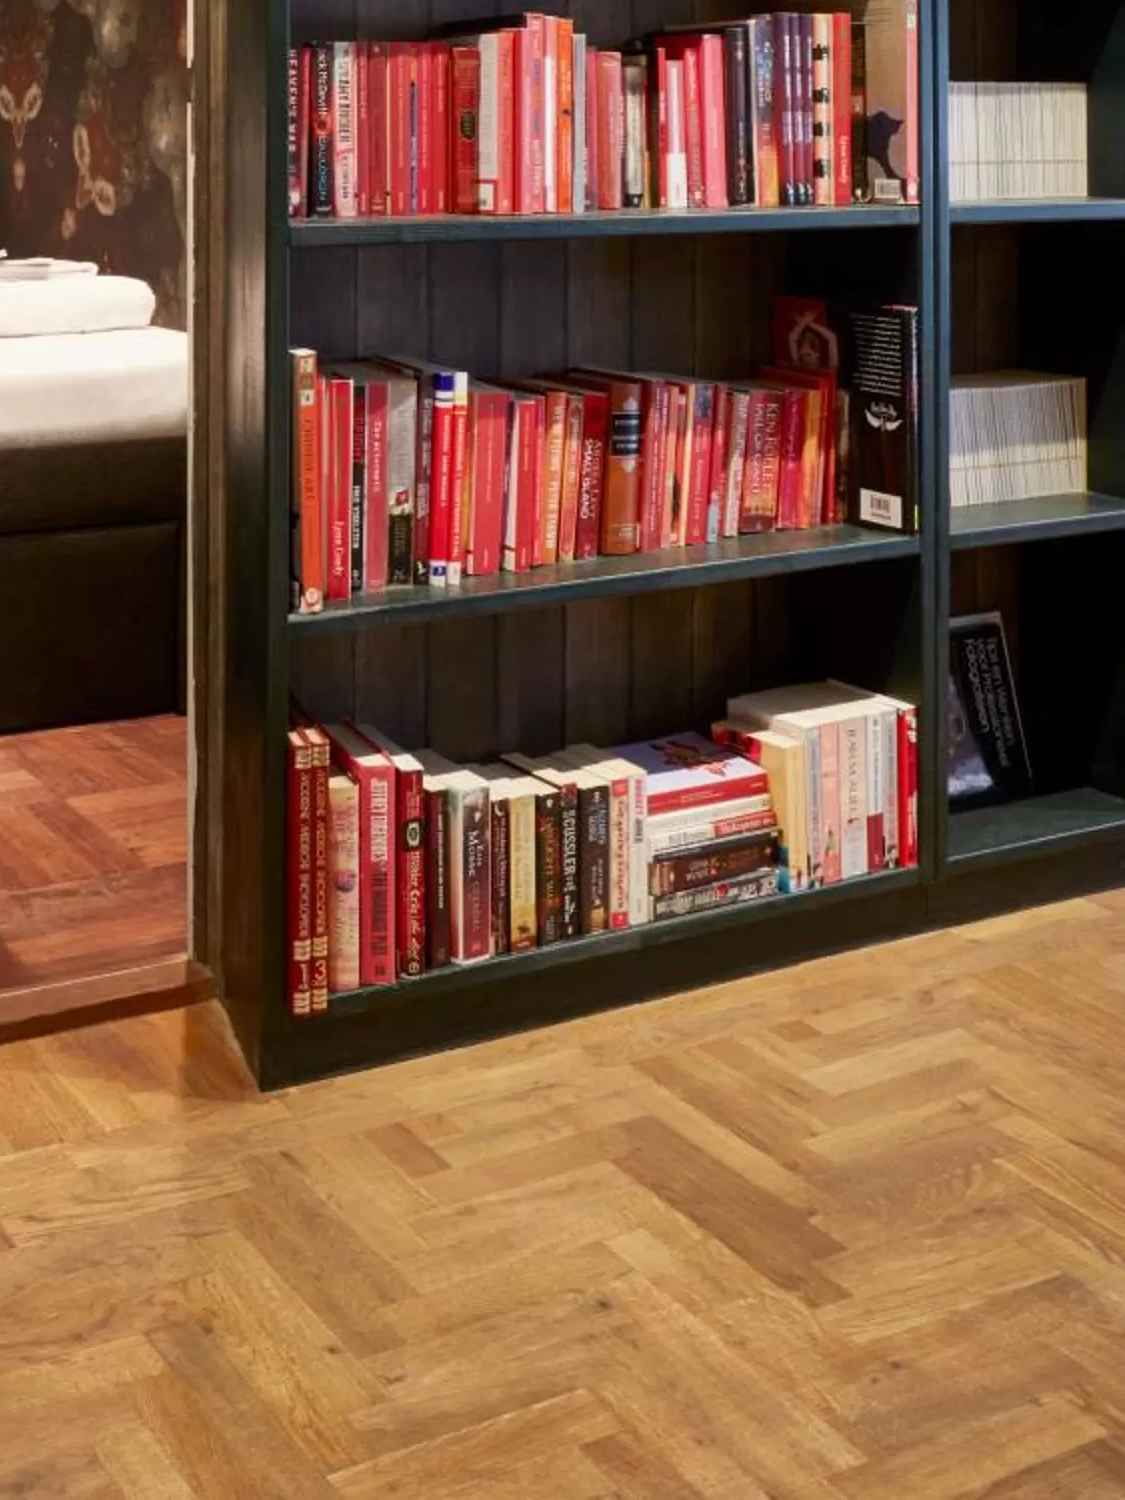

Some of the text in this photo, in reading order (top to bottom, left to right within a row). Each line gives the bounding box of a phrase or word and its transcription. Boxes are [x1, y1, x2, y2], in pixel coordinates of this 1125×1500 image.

[317, 71, 329, 116] McDevitt
[766, 403, 779, 433] KEN
[580, 439, 594, 519] SMALL ISLAND
[370, 778, 388, 862] JEFFREY EUGENIDES
[563, 818, 576, 876] CUSSLER
[315, 960, 327, 981] 3
